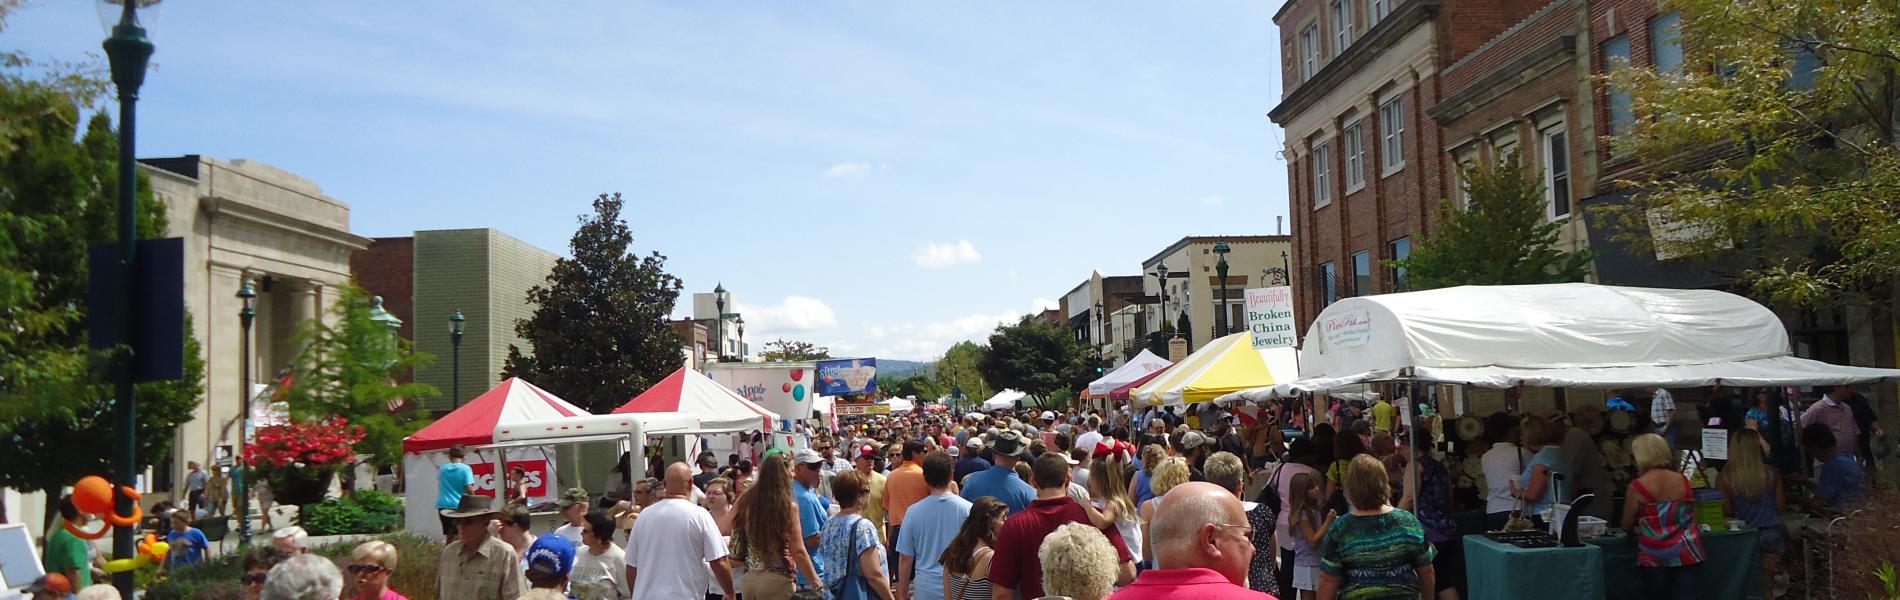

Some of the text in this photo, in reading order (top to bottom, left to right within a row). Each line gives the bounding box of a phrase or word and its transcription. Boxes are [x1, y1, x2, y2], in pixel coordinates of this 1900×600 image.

[1248, 290, 1289, 308] Beautifully
[1249, 310, 1291, 321] Broken
[1253, 323, 1291, 333] China
[1252, 334, 1294, 347] Jewelry
